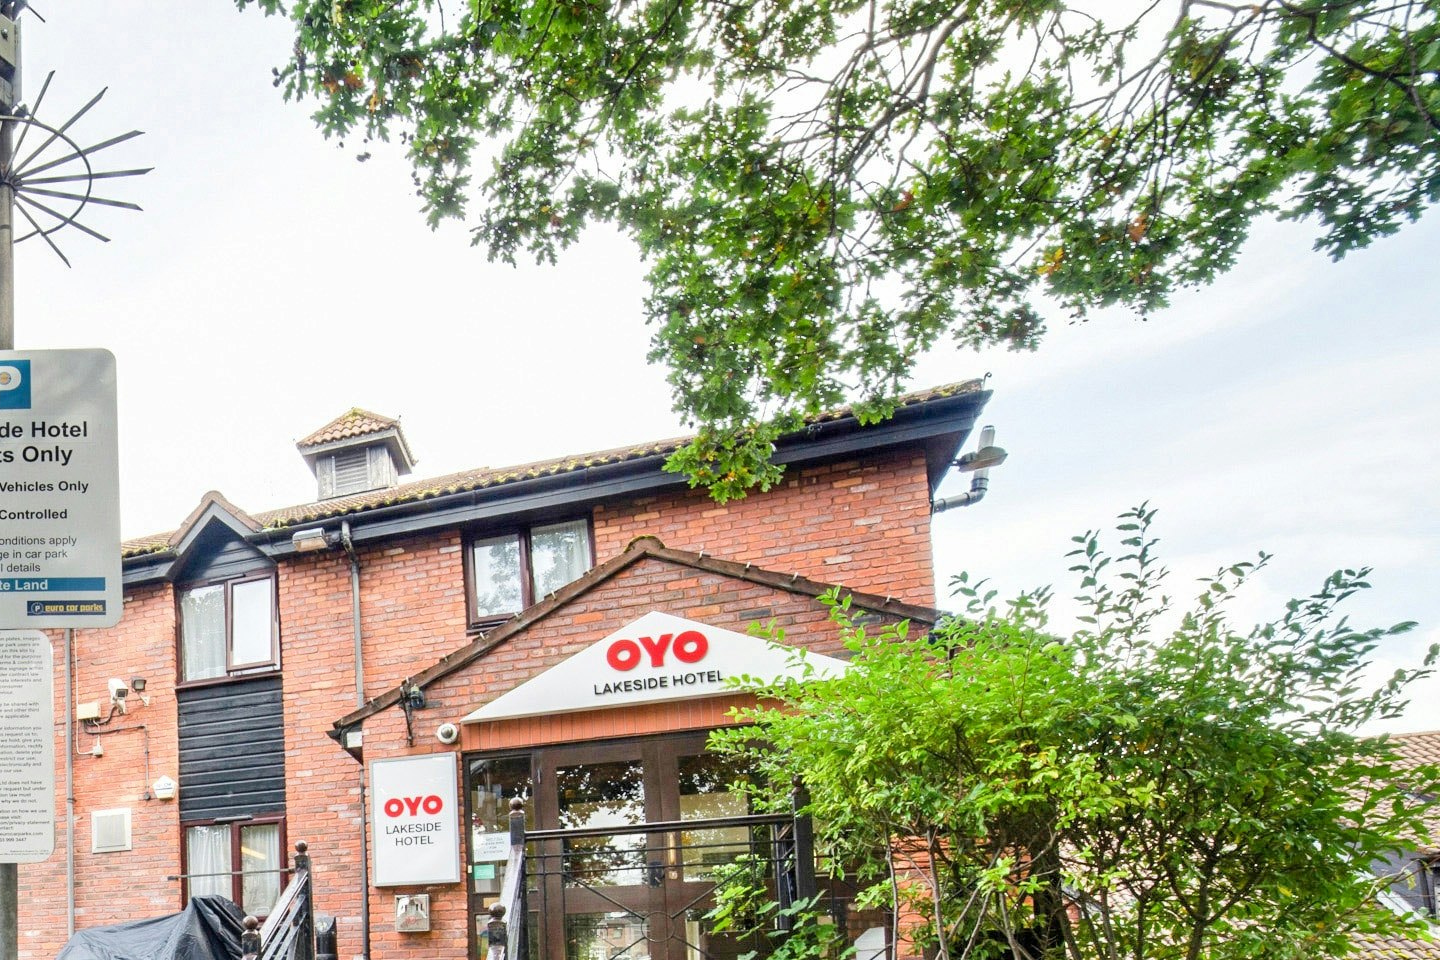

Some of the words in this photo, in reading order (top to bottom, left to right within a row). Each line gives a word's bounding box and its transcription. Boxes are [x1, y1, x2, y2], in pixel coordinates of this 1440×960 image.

[31, 421, 89, 438] Hotel
[22, 445, 73, 466] Only
[58, 480, 89, 494] Only
[48, 535, 77, 549] apply
[13, 549, 22, 559] in
[25, 551, 42, 559] car
[44, 549, 68, 561] park
[6, 562, 41, 573] details
[14, 580, 48, 591] Land
[45, 605, 64, 613] euro
[79, 604, 104, 613] parks
[606, 630, 709, 672] OYO
[594, 676, 668, 696] LAKESIDE
[672, 670, 723, 687] HOTEL
[384, 795, 443, 818] OYO
[385, 822, 442, 835] LAKESIDE
[395, 835, 434, 846] HOTEL
